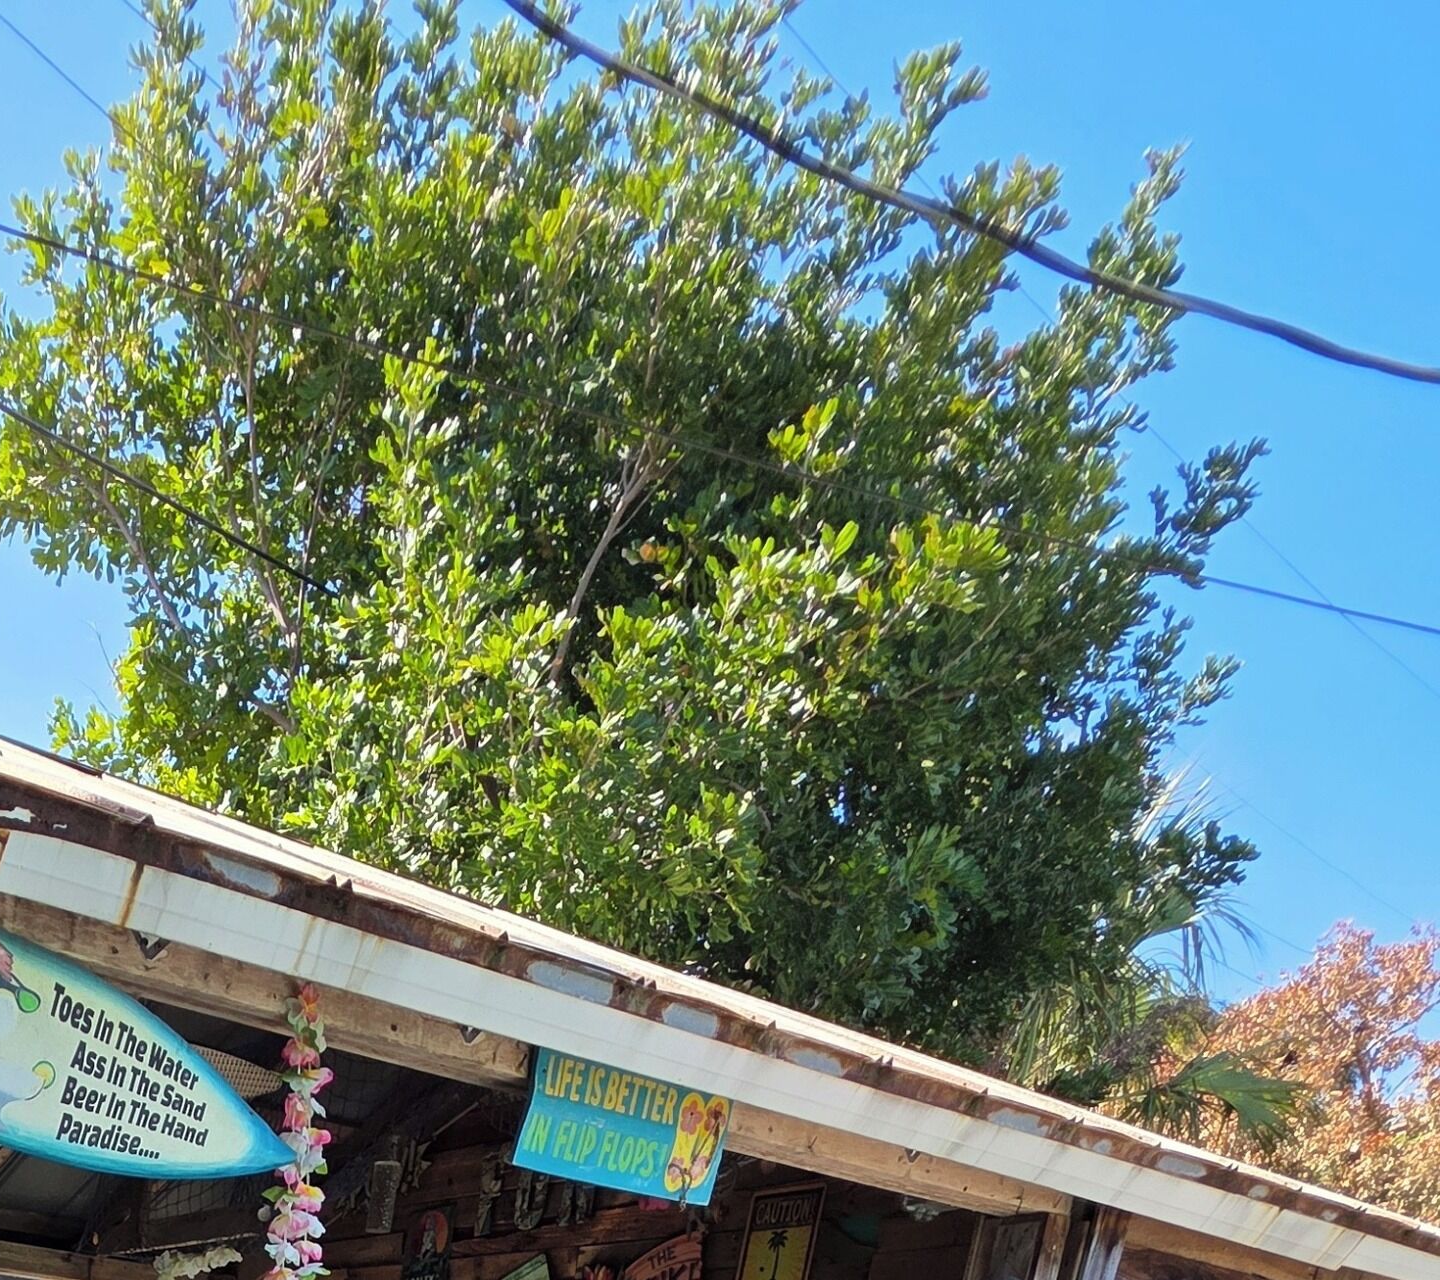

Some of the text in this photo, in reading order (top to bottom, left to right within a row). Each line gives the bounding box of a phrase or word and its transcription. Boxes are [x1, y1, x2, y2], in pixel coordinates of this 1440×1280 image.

[50, 982, 199, 1090] Toes In The Water
[61, 1076, 209, 1147] Beer In The Hand
[70, 1040, 207, 1122] Ass In The Sand
[544, 1056, 678, 1125] LIFE IS BETTER
[522, 1112, 552, 1153] IN
[552, 1117, 597, 1164] FLIP
[648, 1245, 677, 1270] THE
